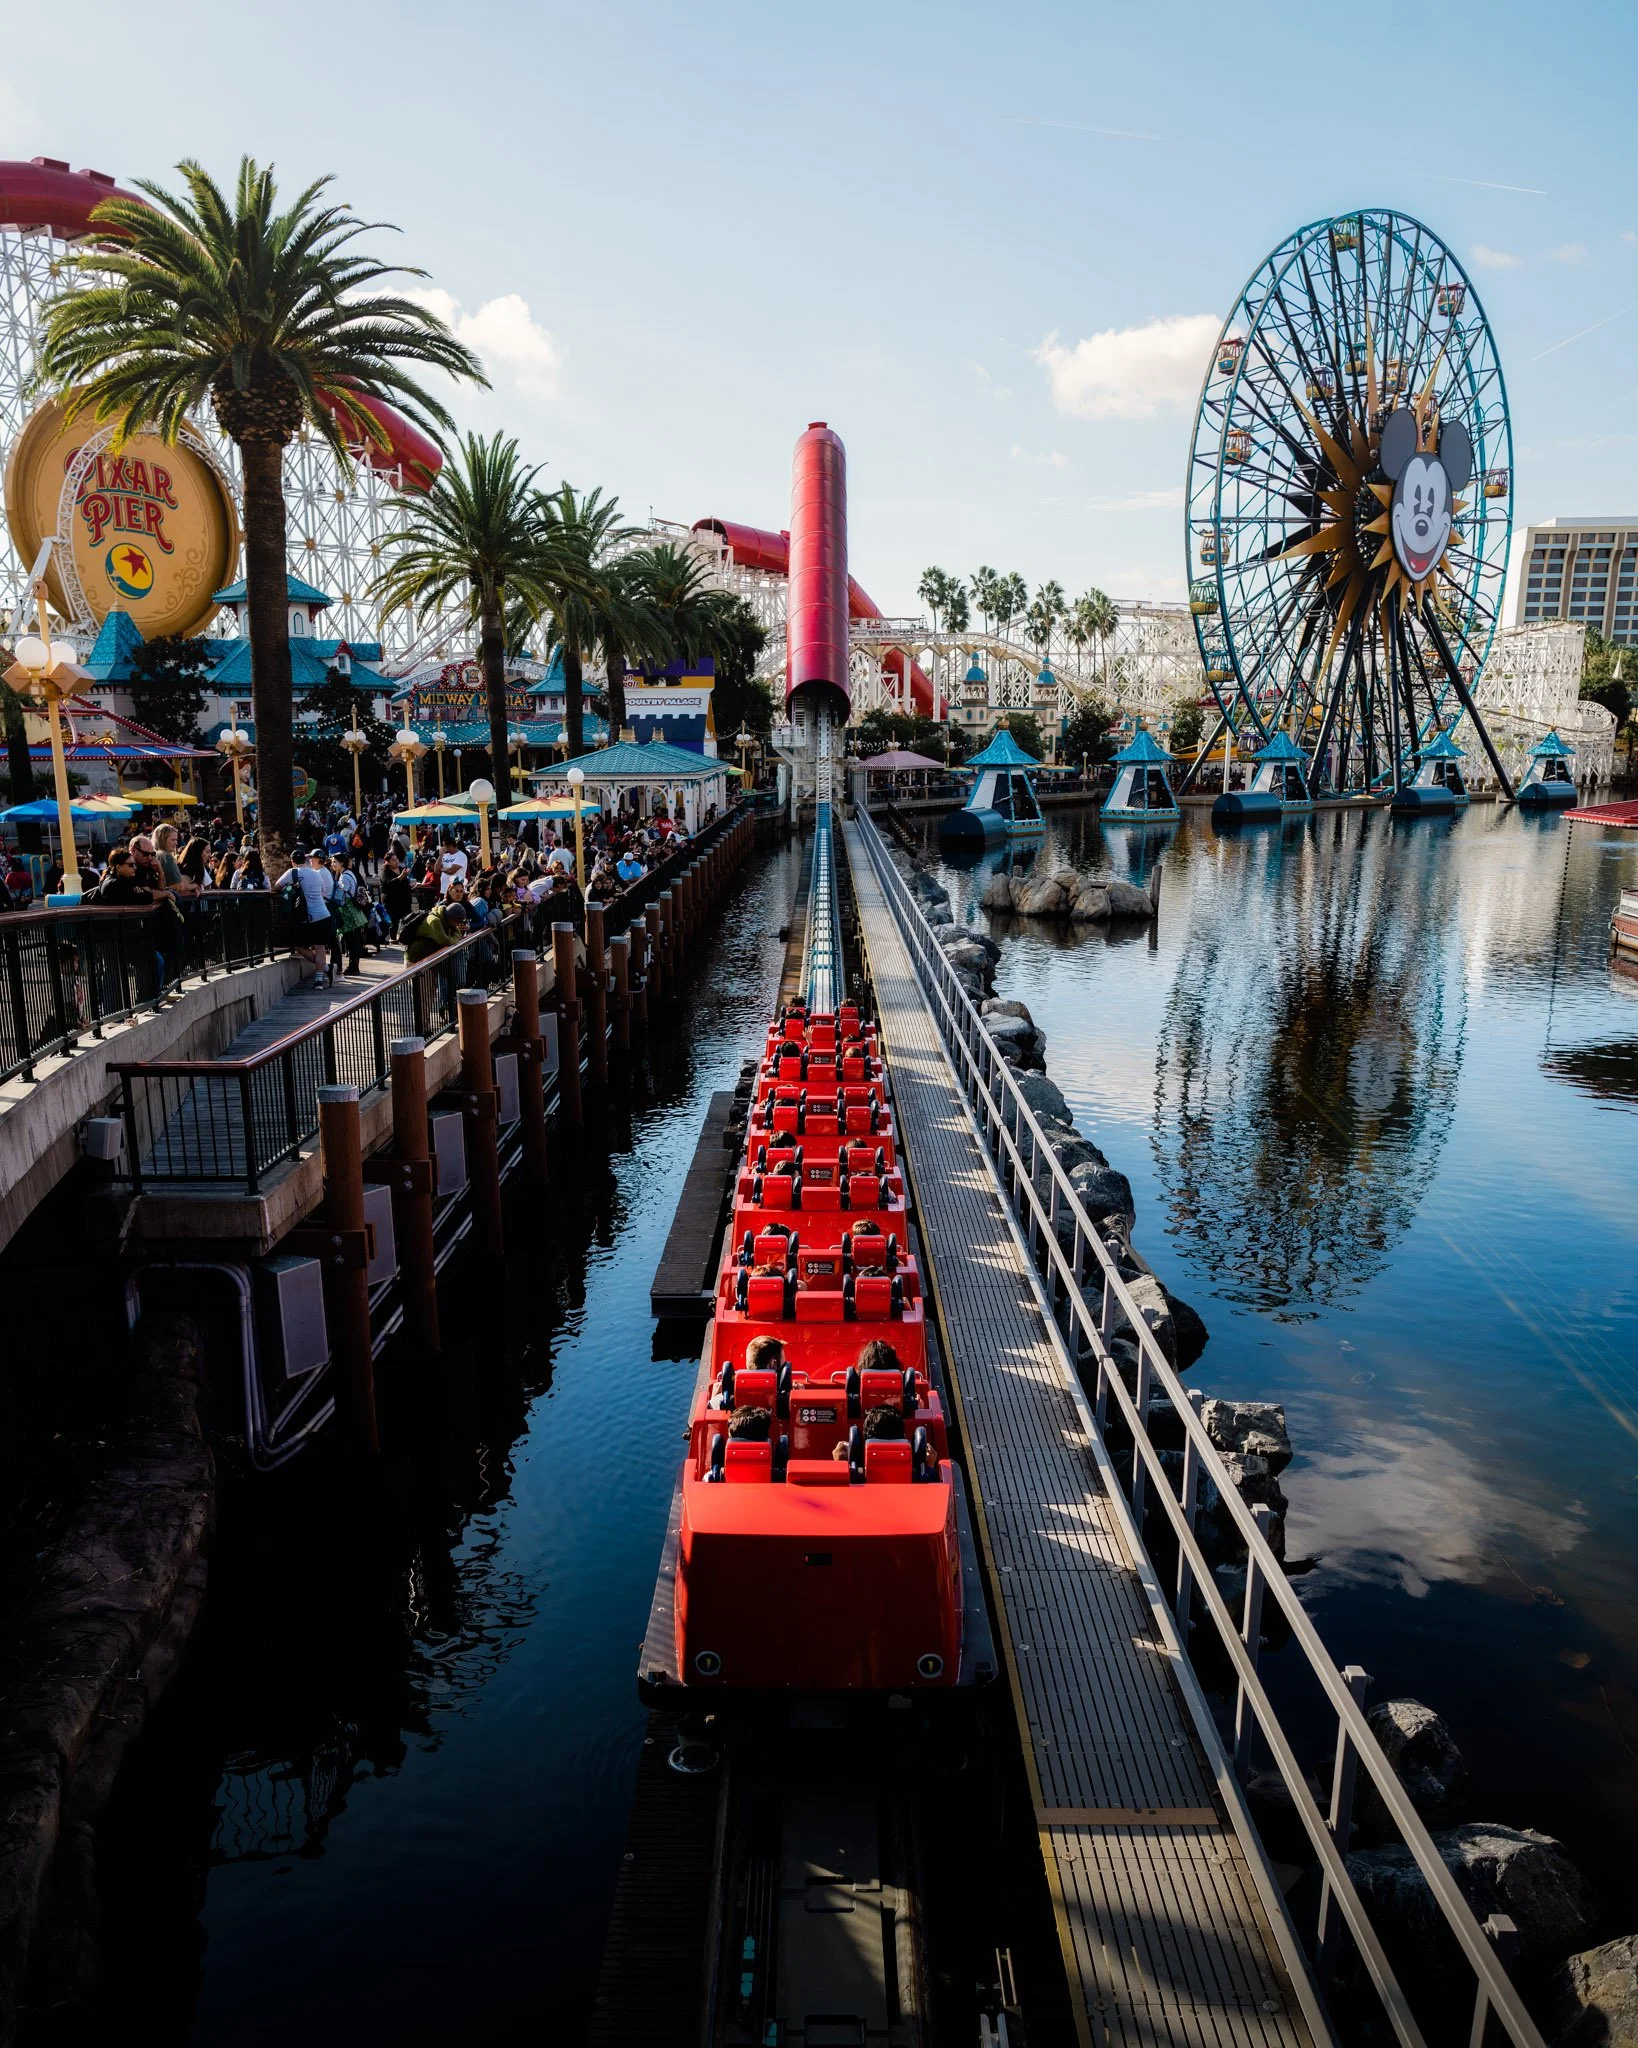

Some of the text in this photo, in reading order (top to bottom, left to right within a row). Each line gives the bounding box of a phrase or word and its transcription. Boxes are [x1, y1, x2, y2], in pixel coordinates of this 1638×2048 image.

[64, 447, 178, 509] PIXAR
[81, 493, 174, 554] PIER
[420, 693, 526, 706] MIDWAY MIA!
[665, 698, 701, 706] PALACE
